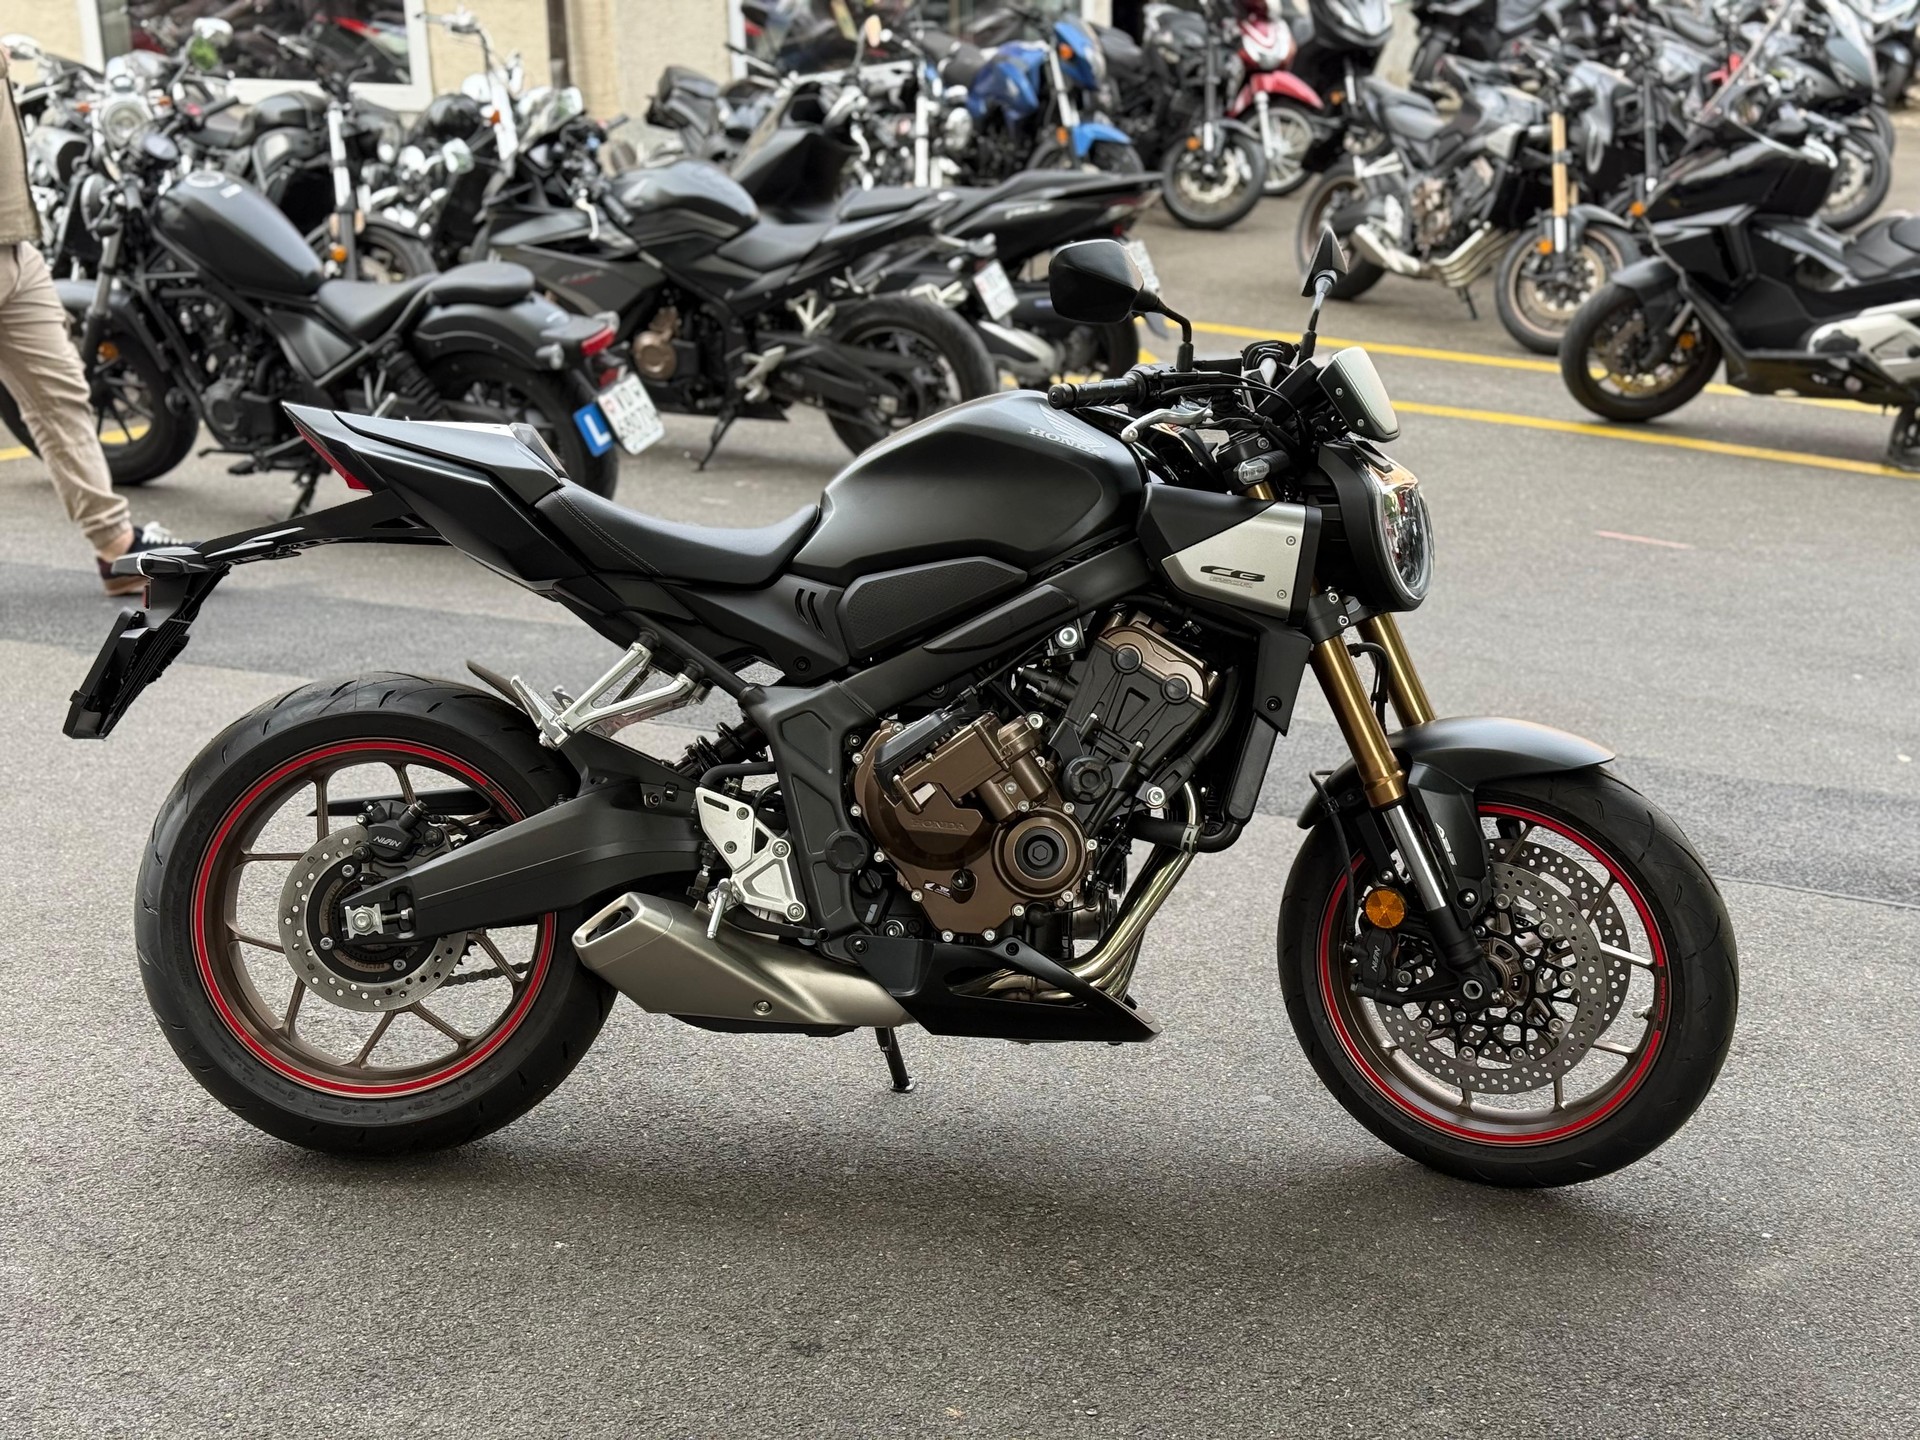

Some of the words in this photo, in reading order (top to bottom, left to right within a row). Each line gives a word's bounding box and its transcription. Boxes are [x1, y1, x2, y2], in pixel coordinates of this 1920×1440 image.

[583, 413, 612, 446] L
[1027, 426, 1101, 457] HONDA
[911, 819, 968, 831] HONDA
[1435, 822, 1457, 866] ABS
